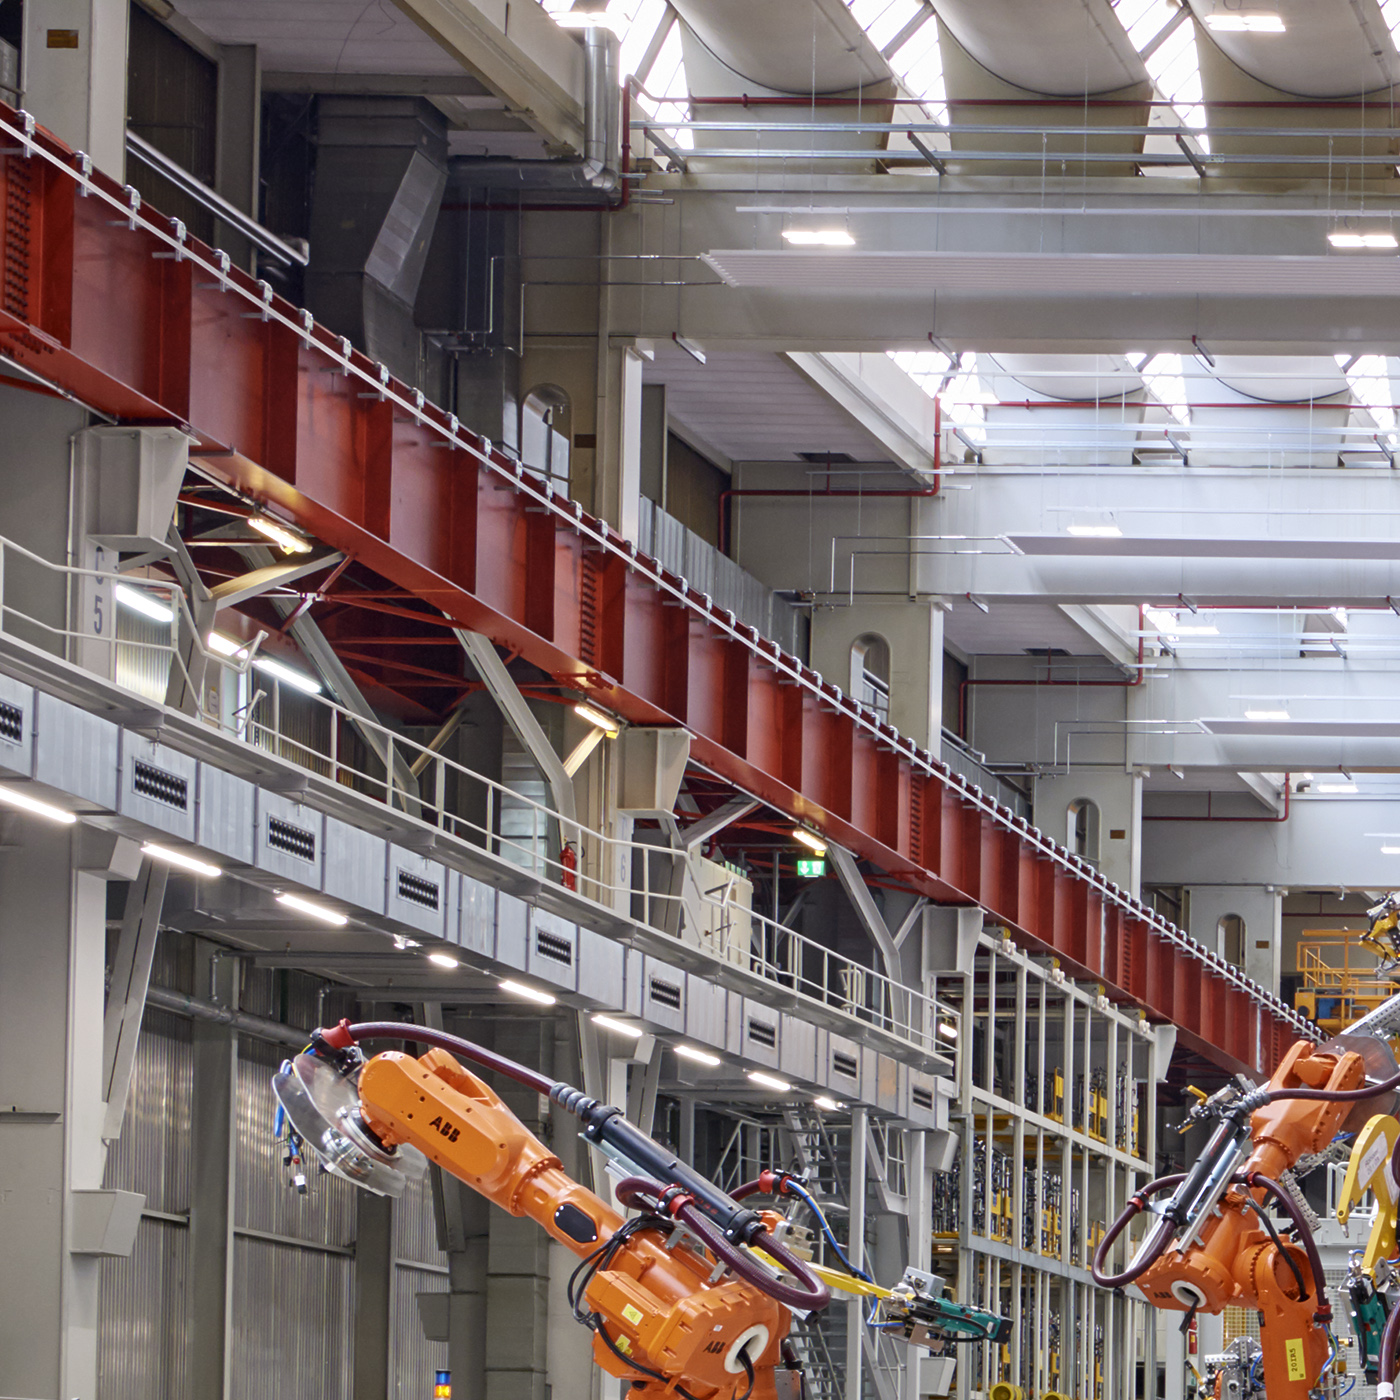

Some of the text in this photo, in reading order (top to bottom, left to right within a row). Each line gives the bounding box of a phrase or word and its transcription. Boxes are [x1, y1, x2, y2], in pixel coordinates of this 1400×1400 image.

[94, 595, 103, 634] 5
[429, 1115, 461, 1143] ABB
[703, 1341, 726, 1354] ABB
